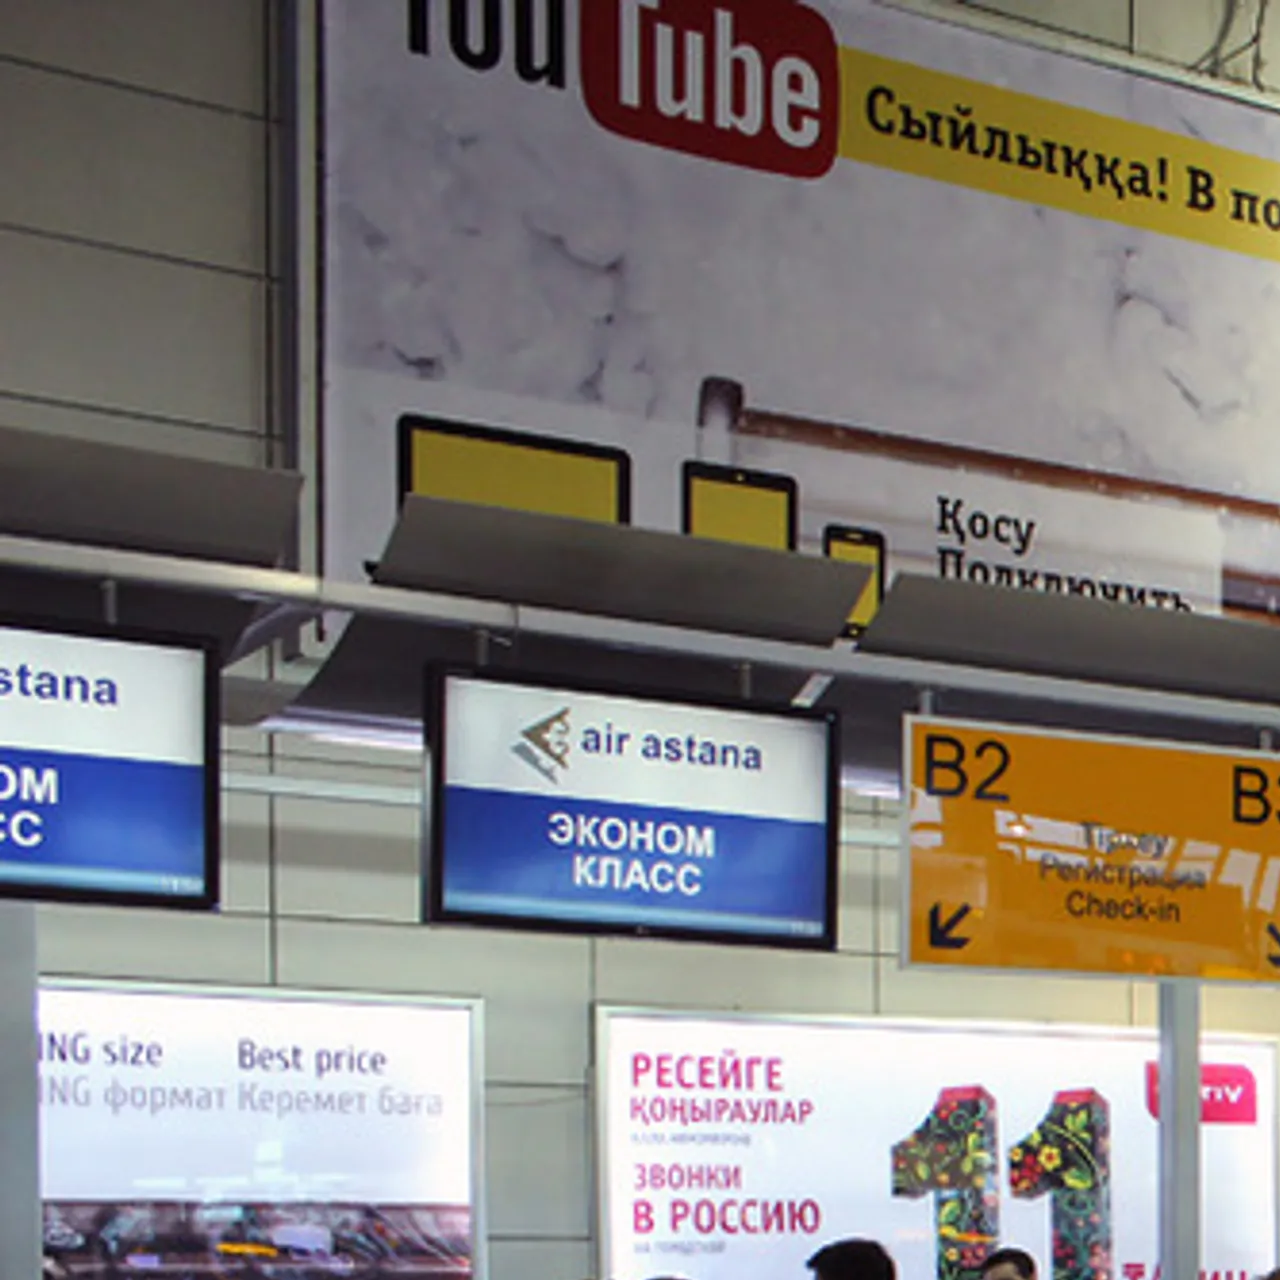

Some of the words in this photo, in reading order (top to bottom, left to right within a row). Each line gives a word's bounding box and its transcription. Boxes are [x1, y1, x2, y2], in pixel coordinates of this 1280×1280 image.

[865, 86, 1169, 200] Сыйлыққа!
[1187, 166, 1215, 210] В
[937, 496, 1035, 554] Қосу
[581, 722, 631, 755] air
[641, 732, 764, 771] astana
[923, 733, 1012, 803] B2
[548, 812, 716, 859] ЭКОНОМ
[572, 855, 703, 897] КЛАСС
[1065, 889, 1182, 923] Check-in
[102, 1033, 164, 1067] size
[237, 1038, 303, 1072] Best
[314, 1044, 388, 1078] price
[631, 1049, 784, 1091] РЕСЕЙГЕ
[104, 1078, 227, 1117] формат
[237, 1082, 366, 1116] Керемет
[629, 1096, 815, 1126] ҚОҢЫРАУЛАР
[634, 1163, 743, 1191] ЗВОНКИ
[632, 1200, 655, 1235] В
[670, 1199, 822, 1235] РОССИЮ
